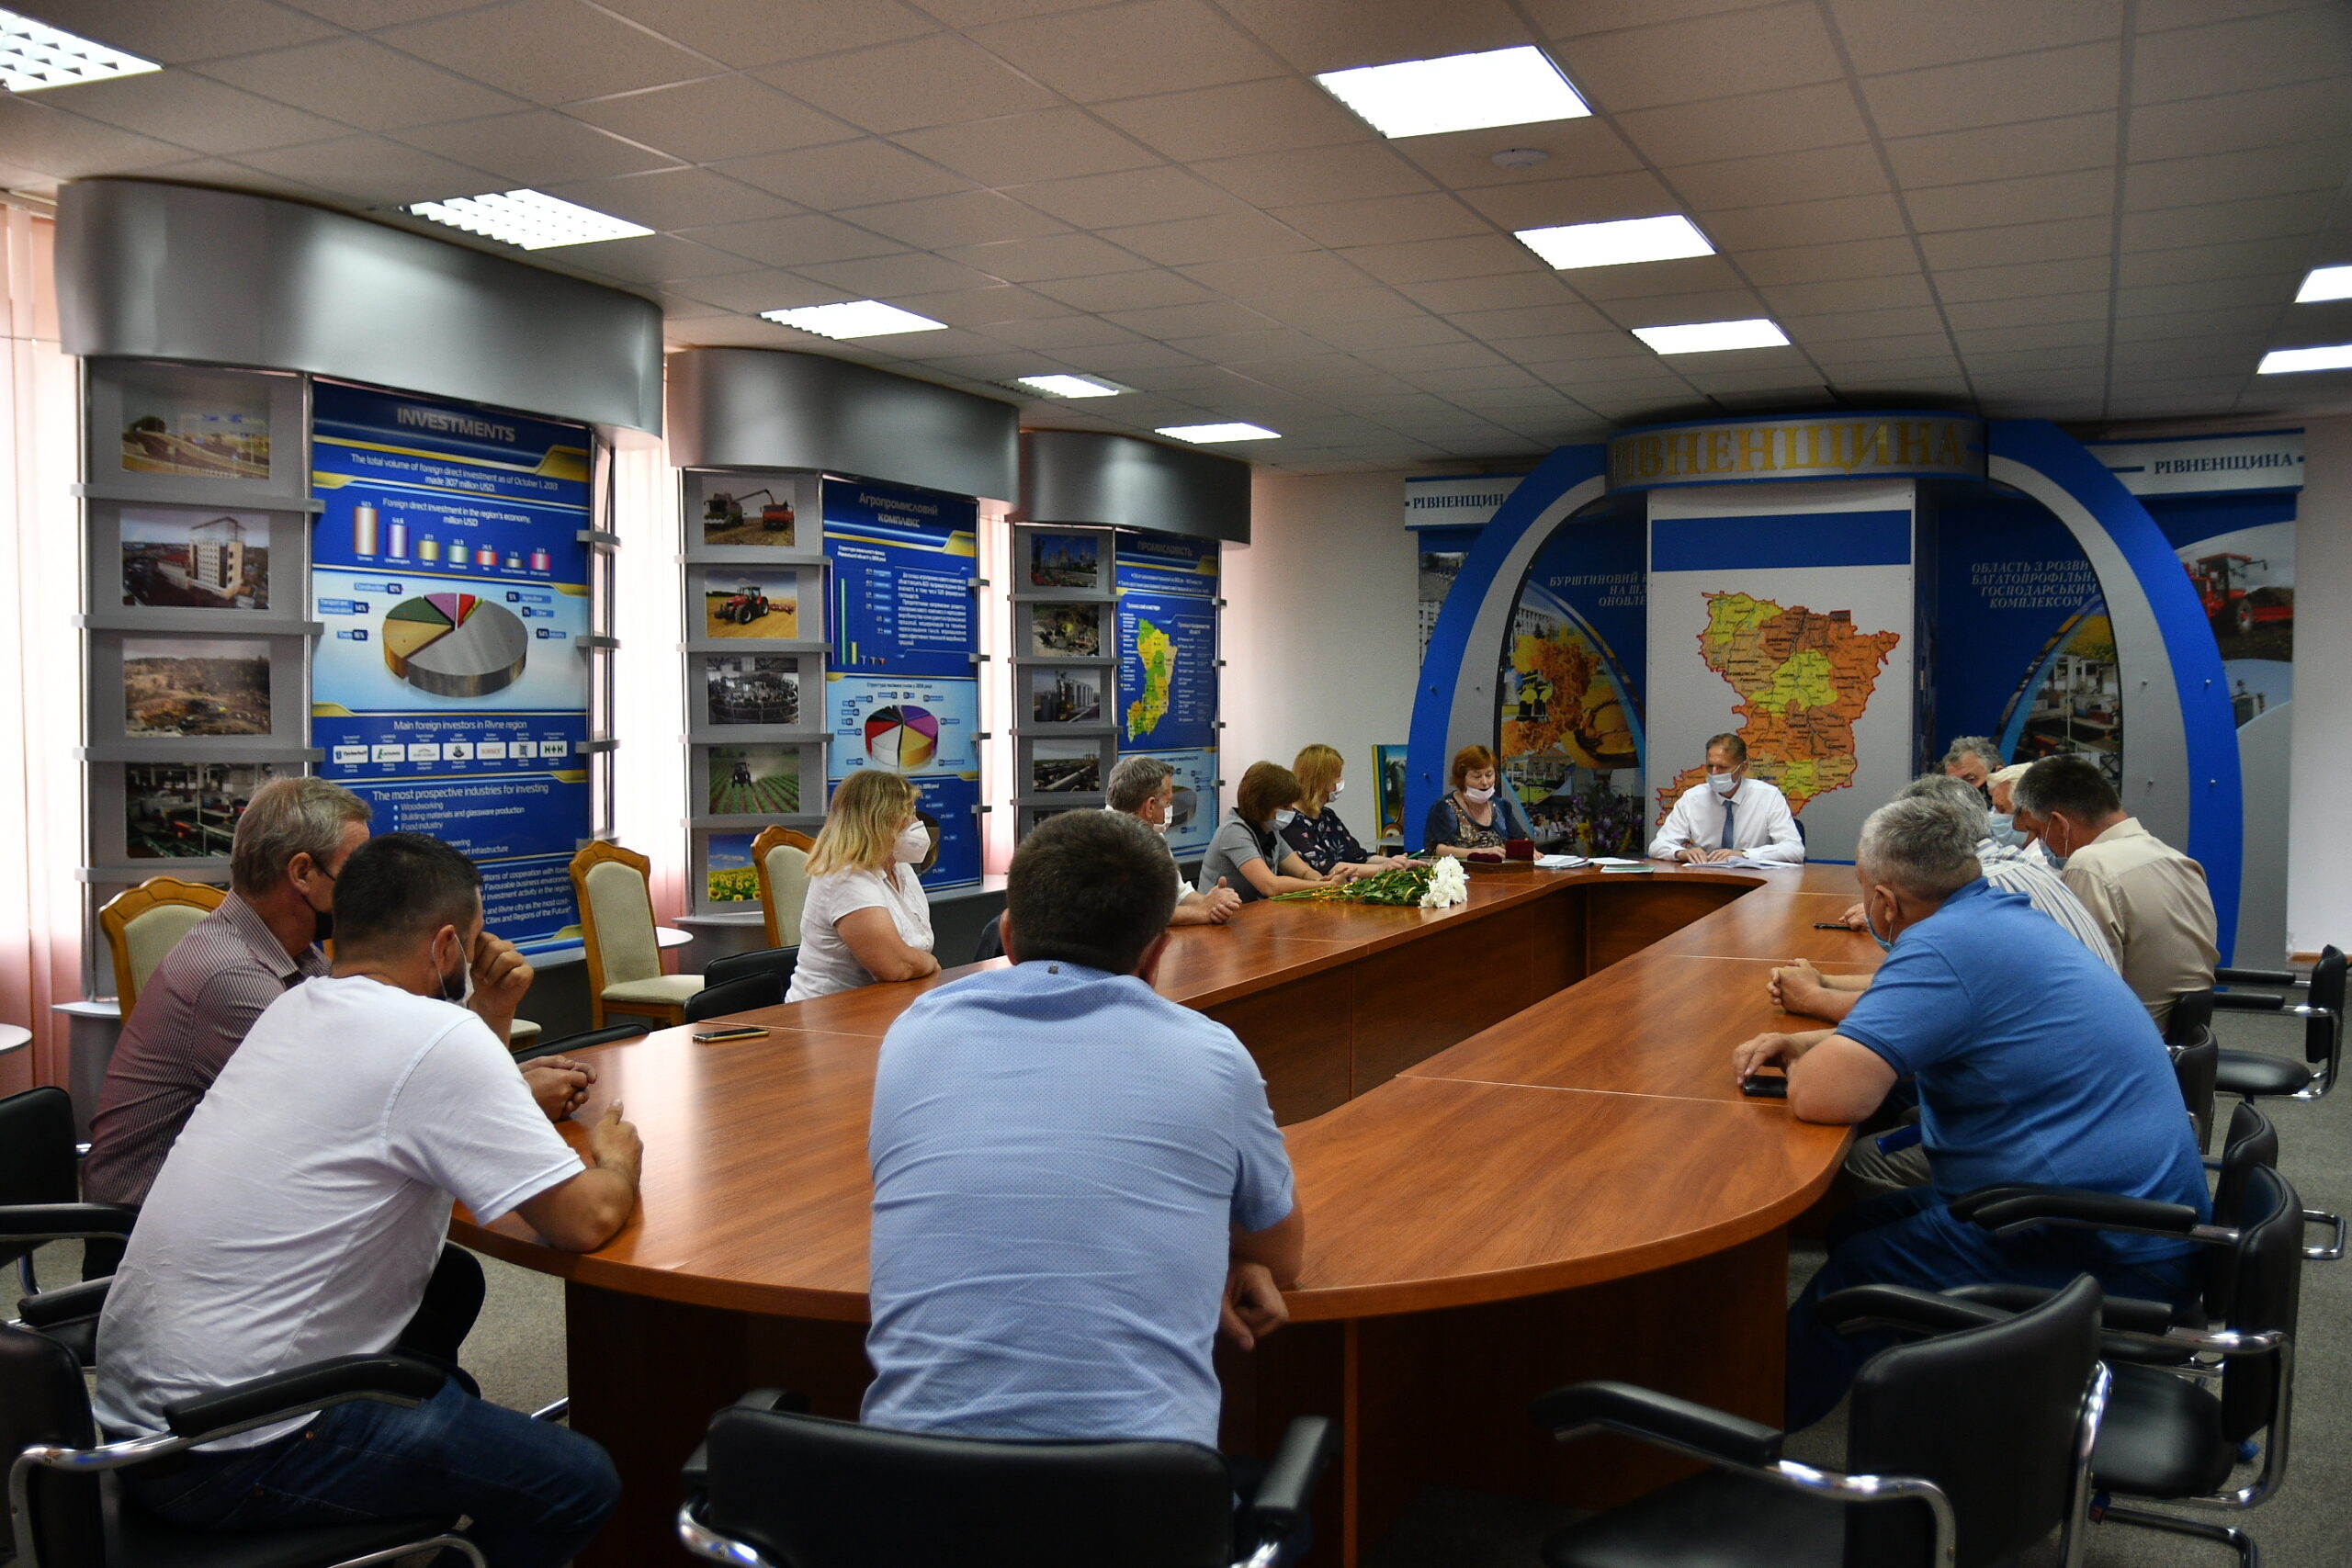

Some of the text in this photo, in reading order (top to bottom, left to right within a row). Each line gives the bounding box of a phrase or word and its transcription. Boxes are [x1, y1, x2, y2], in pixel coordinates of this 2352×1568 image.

[397, 407, 515, 442] INVESTMENTS
[1611, 422, 1962, 482] РІВНЕНЩИНА
[351, 453, 367, 464] The
[385, 458, 410, 470] volume
[411, 461, 419, 471] of
[420, 463, 444, 476] foreign
[444, 466, 462, 477] direct
[463, 468, 497, 482] investment
[2154, 453, 2292, 474] РІВНЕНЩИНА
[425, 475, 444, 485] made
[382, 497, 409, 512] Foreign
[1413, 493, 1504, 510] РІВНЕНЩИН
[1972, 559, 2089, 573] ОБЛАСТЬ З РОЗВИ
[1550, 572, 1638, 586] БУРШТИНОВИЙ
[1972, 572, 2096, 585] БАГАТОПРОФІЛЬН
[1610, 586, 1625, 595] НА
[1981, 584, 2097, 596] ГОСПОДАРСЬКИМ
[1599, 596, 1646, 606] ОНОВЛЕ
[1990, 596, 2083, 608] КОМПЛЕКСОМ
[394, 719, 527, 732] Main foreign investors in Rivne region
[372, 784, 548, 802] The most prospective industries for investing
[401, 802, 444, 811] Woodworking
[401, 813, 425, 822] Building
[426, 811, 454, 819] materials
[455, 809, 466, 818] and
[495, 807, 526, 817] production
[401, 821, 443, 831] Food industry
